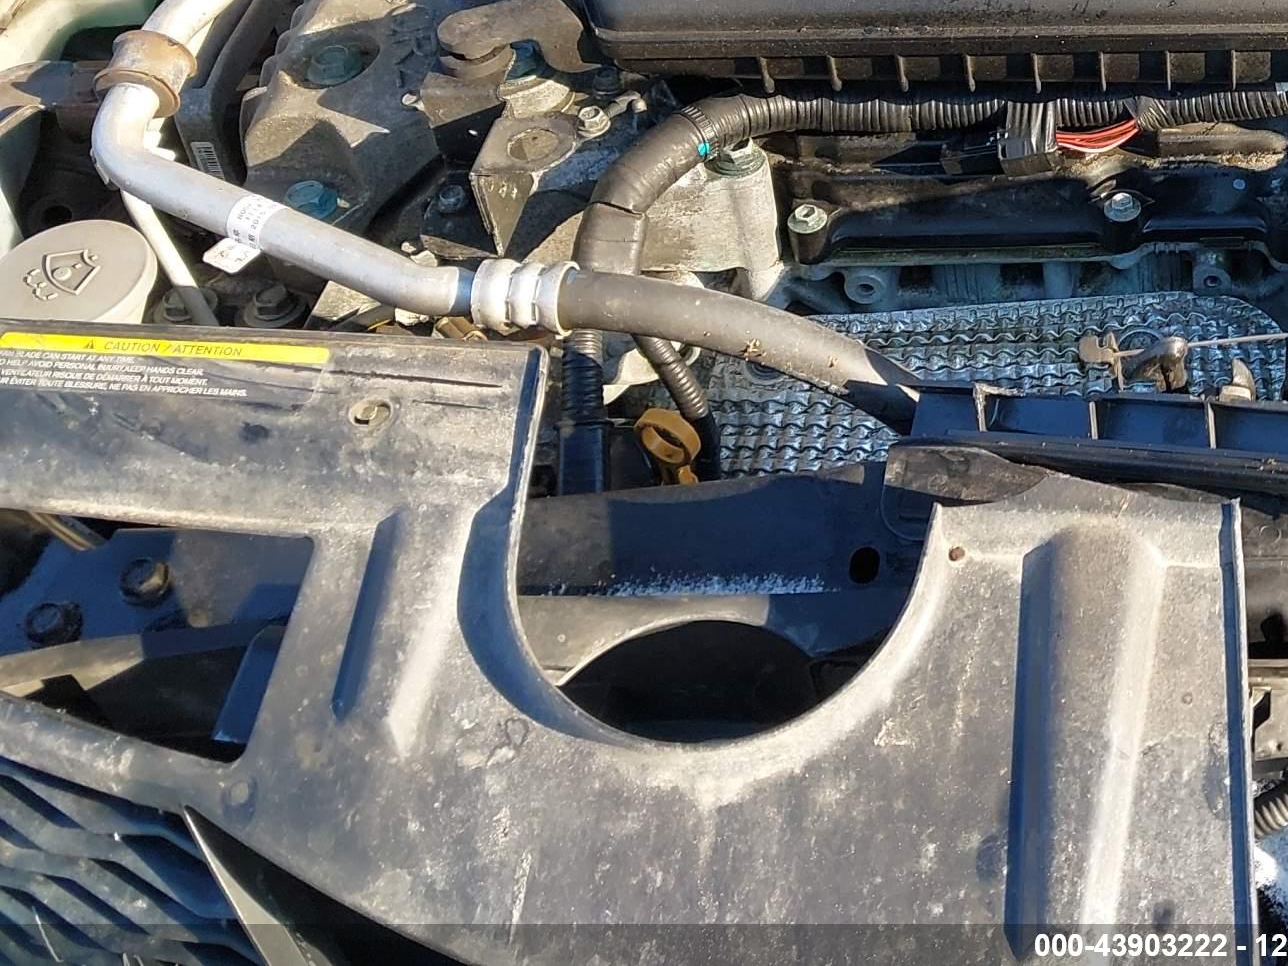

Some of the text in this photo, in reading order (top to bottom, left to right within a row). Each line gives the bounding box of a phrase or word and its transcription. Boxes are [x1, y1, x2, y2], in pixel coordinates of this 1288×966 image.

[104, 341, 161, 353] CAUTION
[172, 344, 243, 357] ATTENTION
[28, 360, 54, 369] AVOID
[53, 361, 97, 372] PERSONAL
[146, 365, 176, 375] HANDS
[52, 371, 83, 380] RISQUE
[82, 372, 96, 381] DE
[149, 376, 172, 385] TOUT
[38, 378, 65, 388] TOUTE
[108, 382, 122, 392] NE
[121, 383, 139, 393] PAS
[151, 385, 203, 396] APPROCHER
